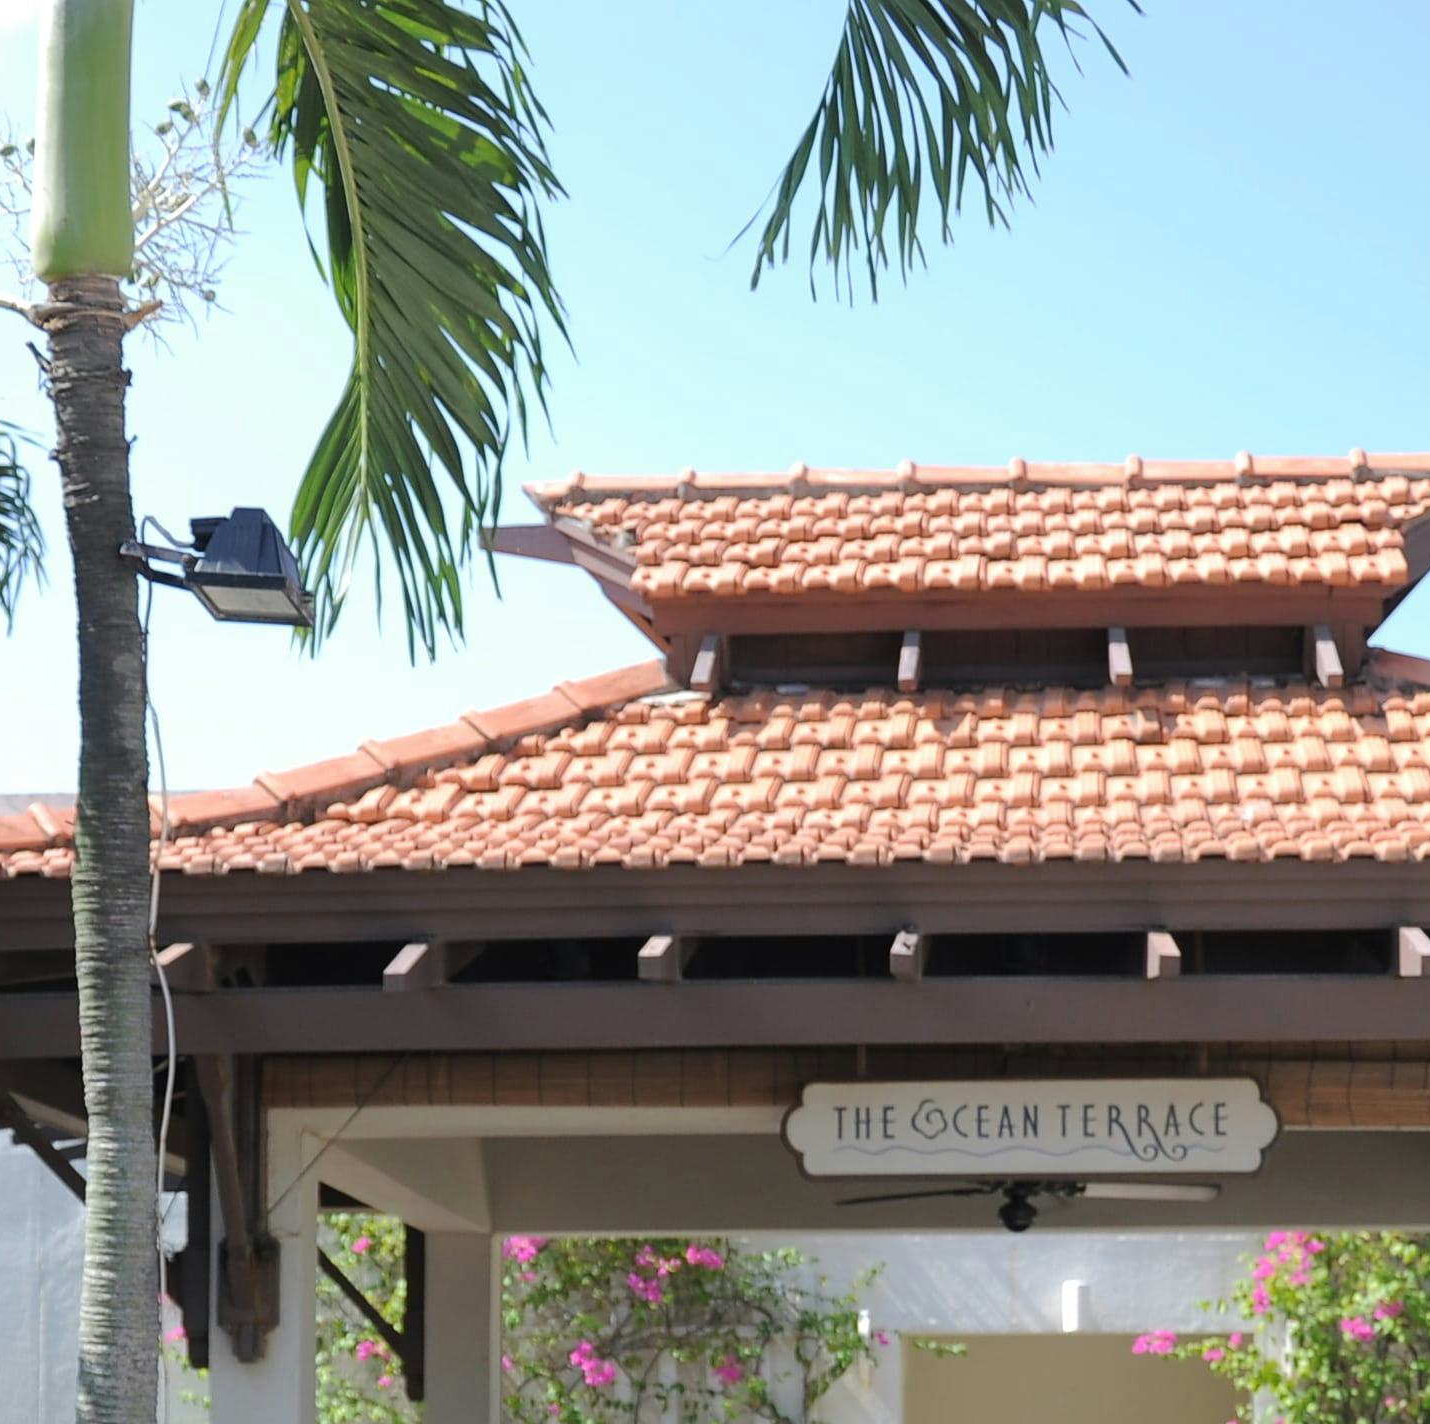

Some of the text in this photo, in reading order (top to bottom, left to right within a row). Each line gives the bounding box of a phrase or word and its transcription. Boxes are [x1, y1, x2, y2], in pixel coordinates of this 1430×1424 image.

[832, 1099, 1230, 1163] THE OCEAN TERRACE
